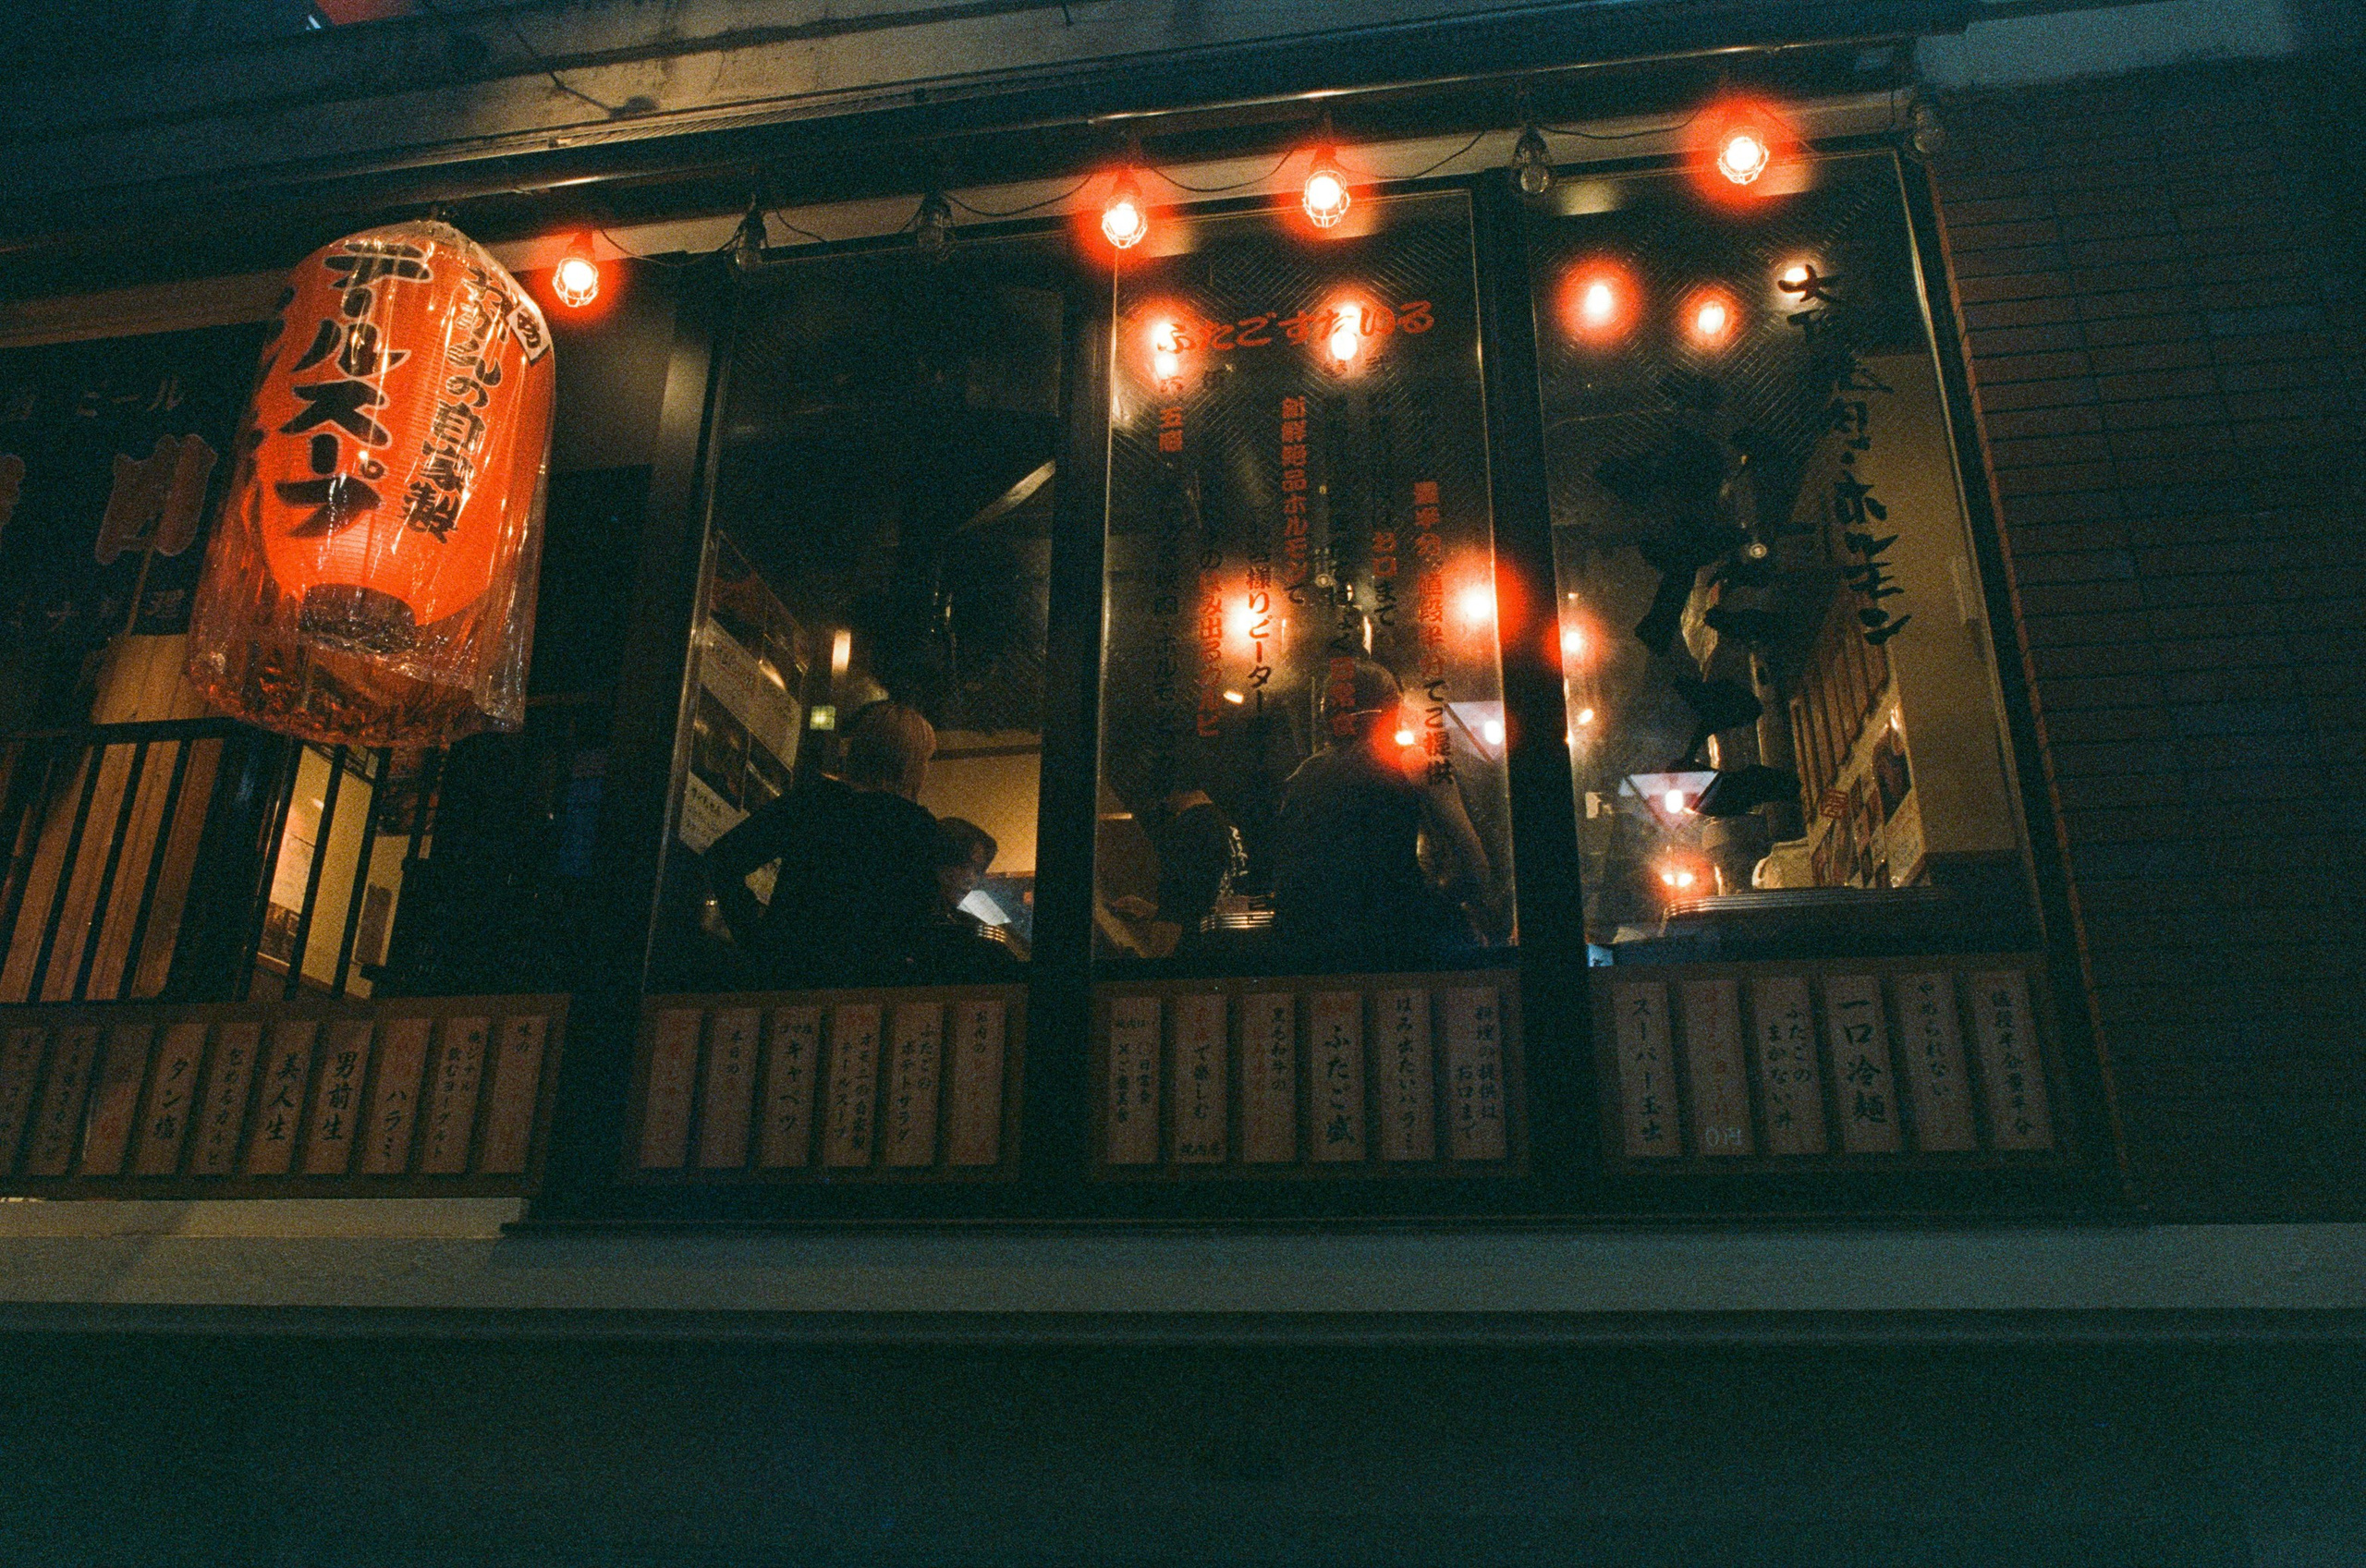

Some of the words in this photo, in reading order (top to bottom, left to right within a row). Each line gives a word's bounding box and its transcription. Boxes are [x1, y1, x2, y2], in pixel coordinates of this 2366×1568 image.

[274, 242, 433, 539] テールスープ
[1839, 999, 1890, 1124] 一口冷麺
